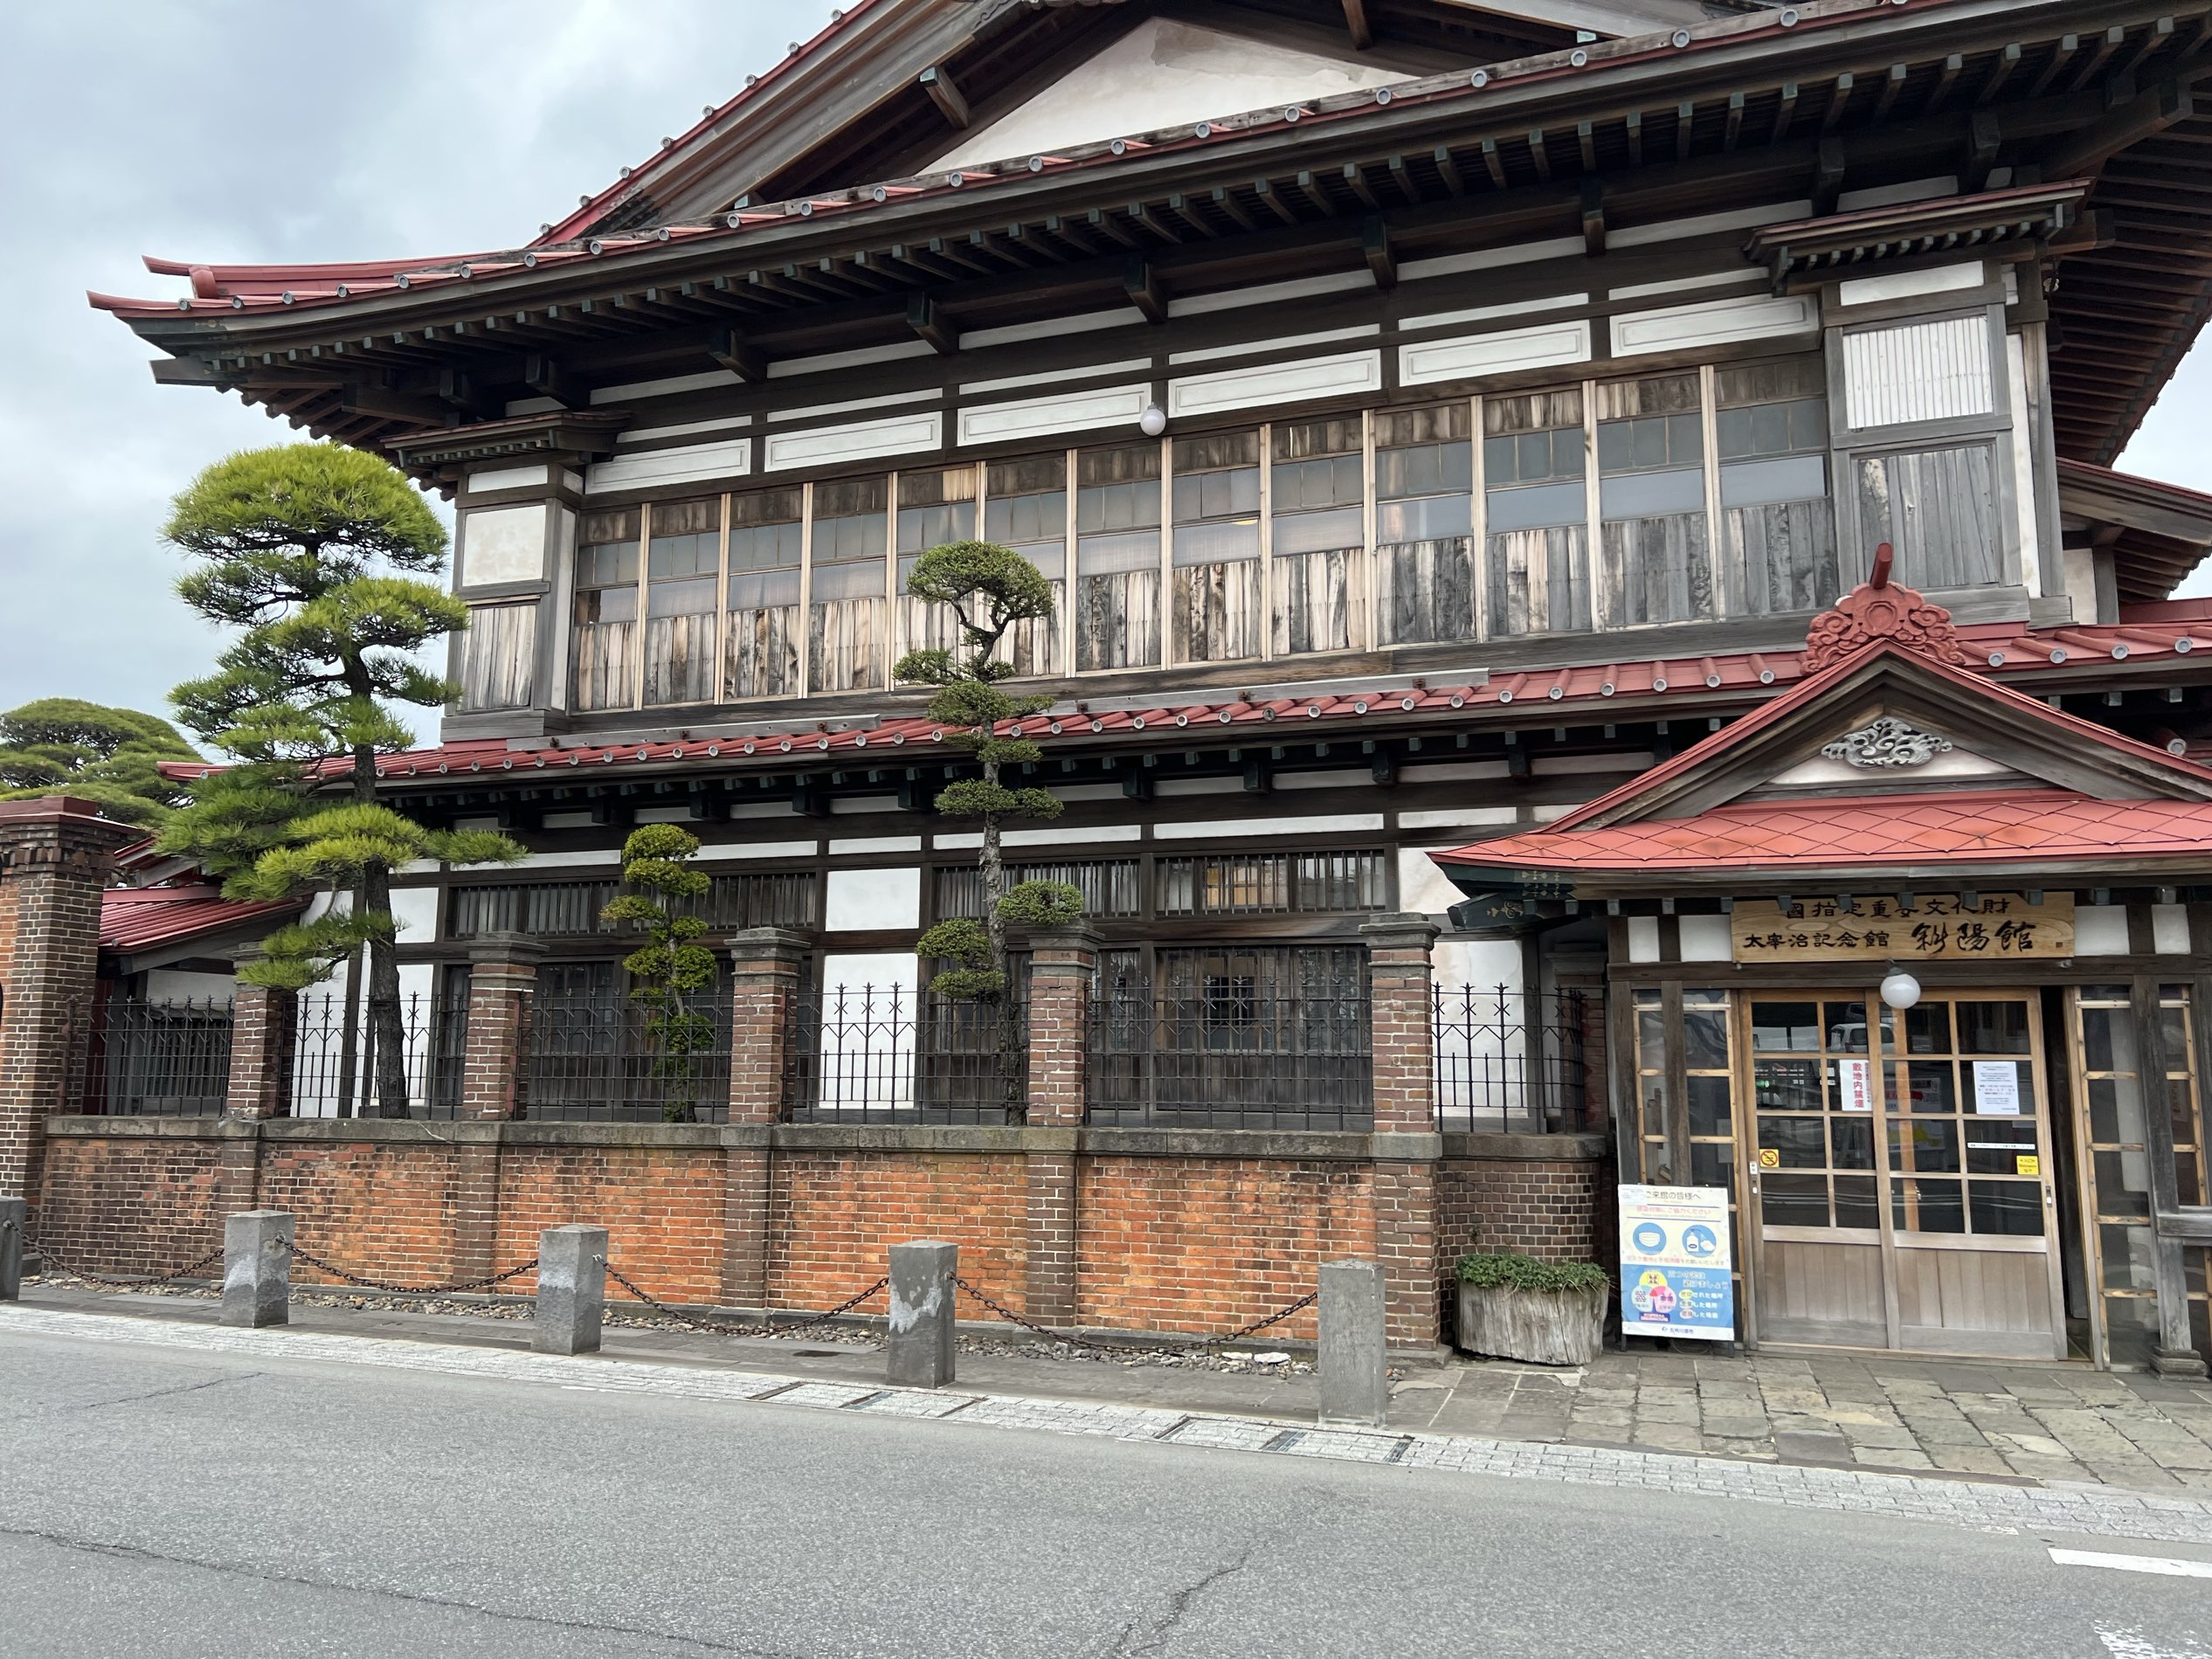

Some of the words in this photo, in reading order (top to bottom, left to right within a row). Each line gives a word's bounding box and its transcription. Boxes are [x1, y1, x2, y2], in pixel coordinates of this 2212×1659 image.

[1743, 930, 1890, 950] 太宰治記念館
[1911, 919, 2036, 955] 斜陽館
[1852, 1062, 1864, 1108] 敷地内禁煙
